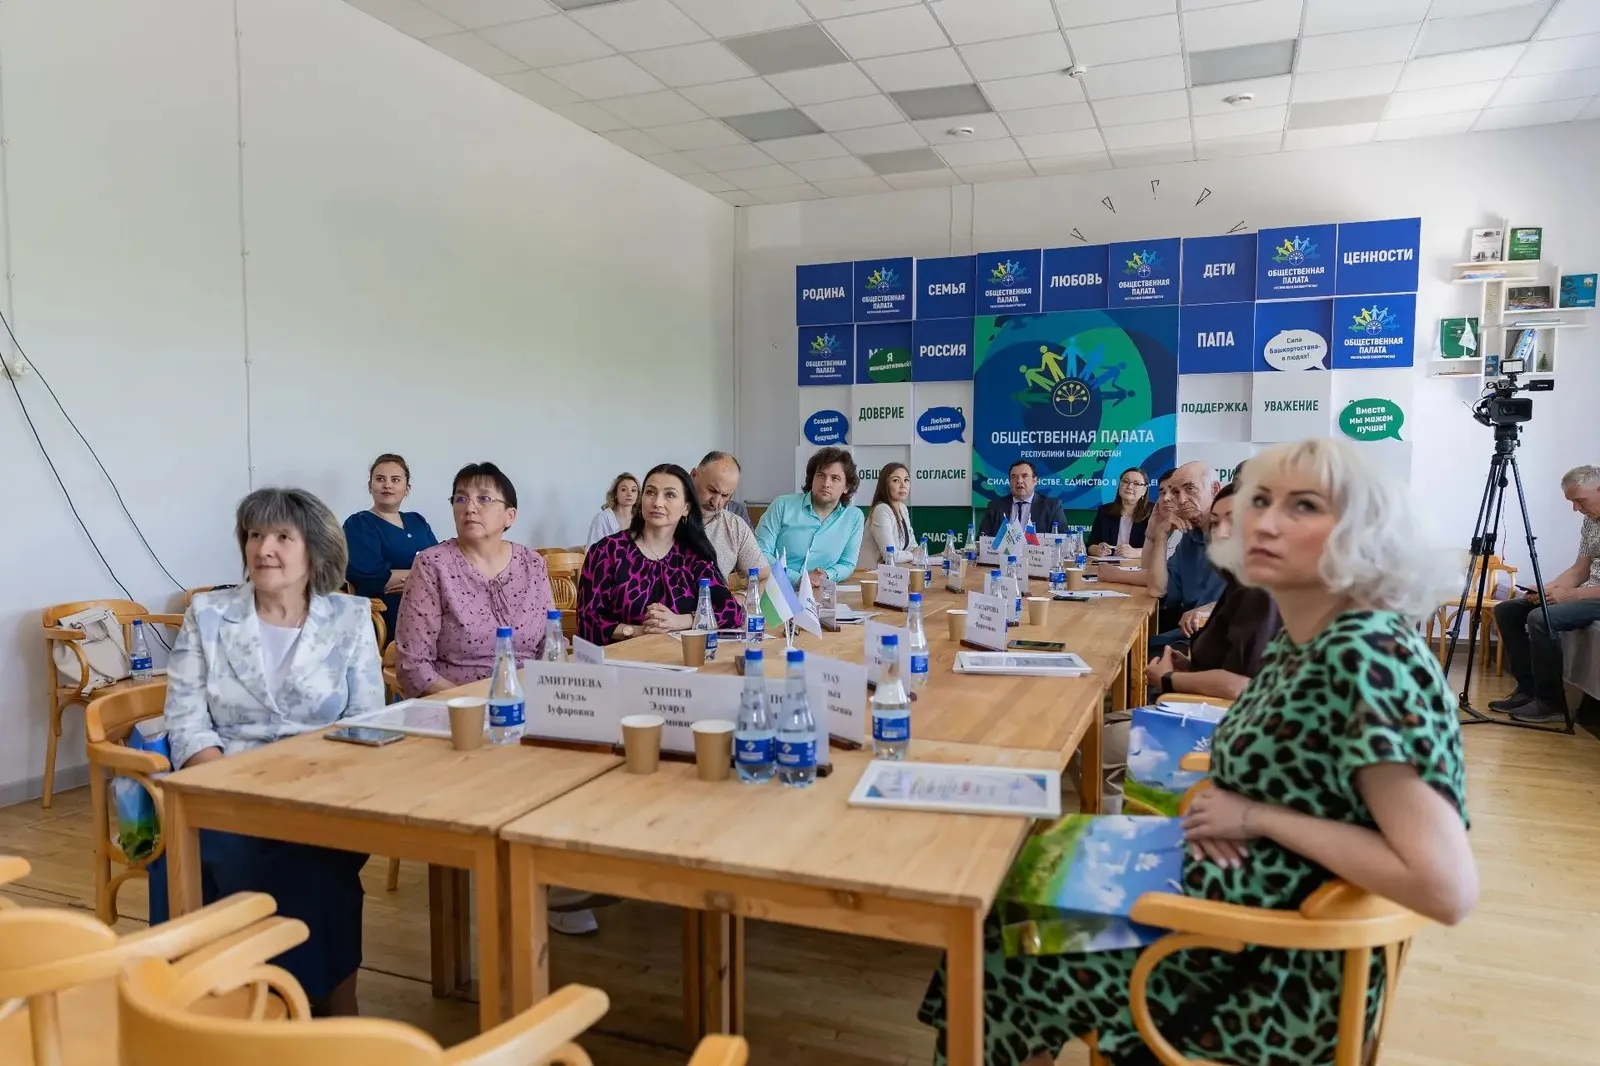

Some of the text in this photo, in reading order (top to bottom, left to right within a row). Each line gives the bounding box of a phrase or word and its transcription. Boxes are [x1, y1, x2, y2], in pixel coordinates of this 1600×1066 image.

[1343, 248, 1414, 266] ЦЕННОСТИ
[1203, 262, 1236, 279] ДЕТИ
[1268, 266, 1325, 277] ОБЩЕСТВЕННАЯ
[1050, 273, 1103, 288] ЛЮБОВЬ
[1118, 278, 1170, 289] ОБЩЕСТВЕННАЯ
[1282, 275, 1309, 284] ПАЛАТА
[802, 286, 846, 301] РОДИНА
[928, 282, 966, 296] СЕМЬЯ
[984, 287, 1032, 298] ОБЩЕСТВЕННАЯ
[1131, 287, 1156, 296] ПАЛАТА
[861, 294, 905, 303] ОБЩЕСТВЕННАЯ
[996, 296, 1019, 304] ПАЛАТА
[872, 302, 894, 310] ПАЛАТА
[1197, 331, 1235, 348] ПАПА
[1344, 337, 1404, 347] ОБЩЕСТВЕННАЯ
[919, 343, 967, 358] РОССИЯ
[1359, 346, 1387, 354] ПАЛАТА
[886, 352, 893, 361] Я
[1286, 352, 1310, 361] людях!
[805, 359, 847, 368] ОБЩЕСТВЕННАЯ
[1180, 402, 1248, 414] ПОДДЕРЖКА
[1264, 399, 1319, 412] УВАЖЕНИЕ
[1355, 406, 1386, 415] Вместе
[858, 406, 904, 421] ДОВЕРИЕ
[930, 417, 951, 425] Люблю
[1349, 415, 1393, 425] мы можем
[1356, 423, 1387, 434] лучше!
[991, 429, 1155, 446] ОБЩЕСТВЕННАЯ ПАЛАТА
[1066, 450, 1122, 458] БАШКОРТОСТАН
[916, 469, 966, 480] СОГЛАСИЕ
[987, 478, 1010, 486] СИЛА
[1065, 478, 1109, 487] ЕДИНСТВО
[1111, 478, 1117, 486] В
[537, 675, 603, 688] ДМИТРИЕВА
[553, 690, 587, 702] Айгуль
[642, 686, 692, 698] АГИШЕВ
[546, 704, 595, 717] Зуфаровна
[649, 700, 686, 714] Эдуард
